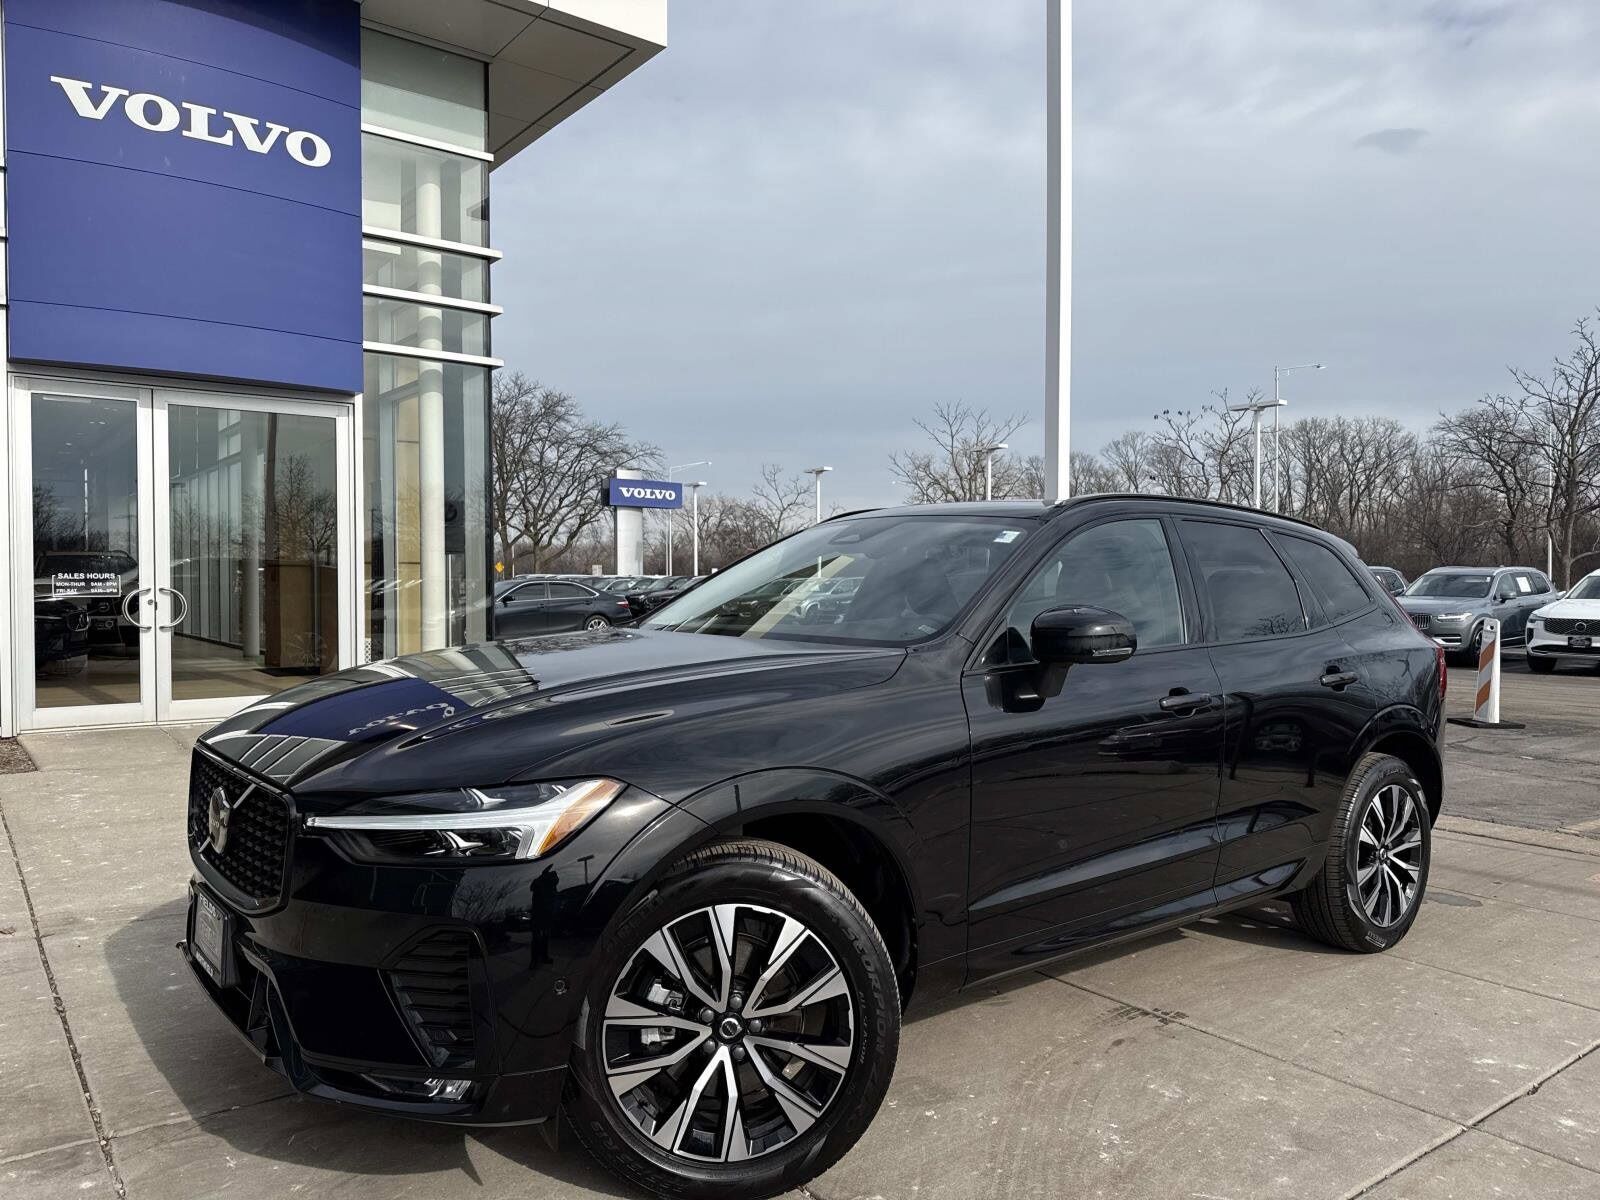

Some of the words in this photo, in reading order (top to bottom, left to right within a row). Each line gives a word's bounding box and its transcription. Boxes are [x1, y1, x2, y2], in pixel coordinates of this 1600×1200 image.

[50, 75, 332, 168] VOLVO
[619, 487, 676, 500] VOLVO
[57, 572, 85, 580] SALES
[86, 572, 115, 580] HOURS
